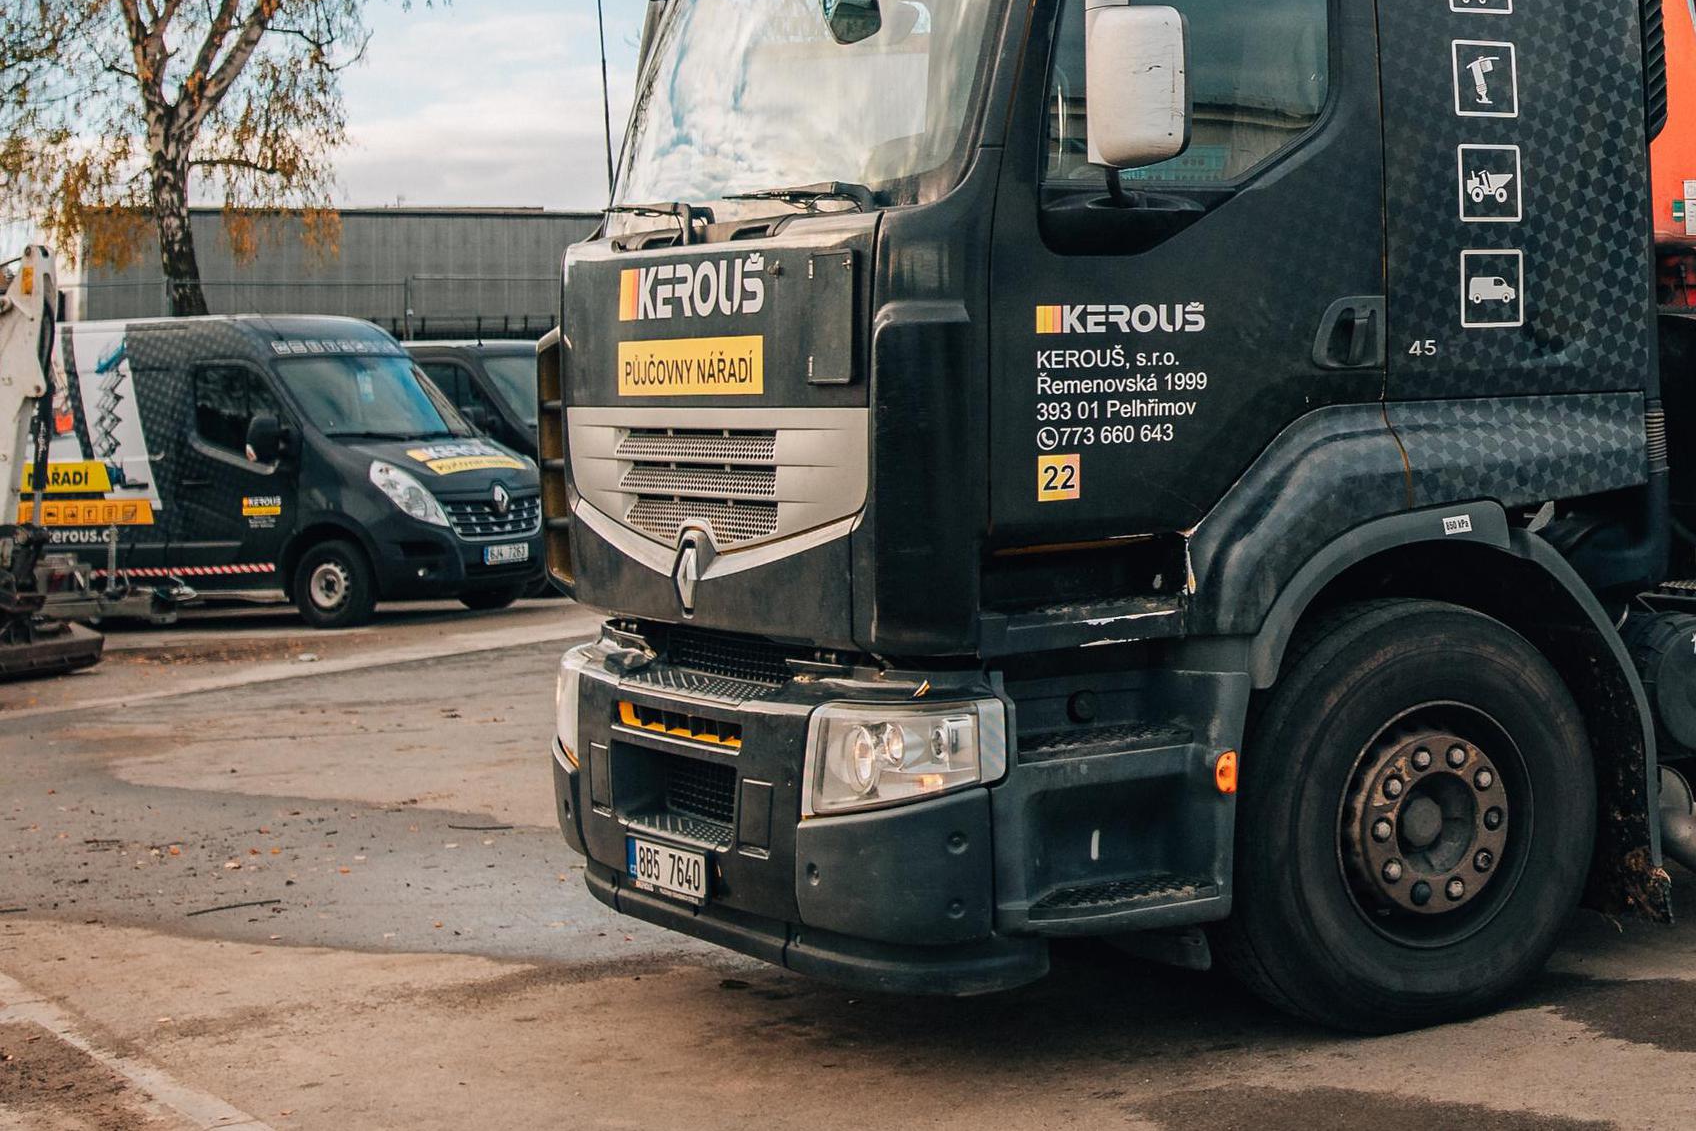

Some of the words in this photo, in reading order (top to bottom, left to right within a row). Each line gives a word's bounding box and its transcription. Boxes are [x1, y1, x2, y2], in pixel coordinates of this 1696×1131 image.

[638, 252, 765, 320] KEROUŠ
[1062, 301, 1206, 334] KEROUŠ
[1036, 345, 1130, 370] KEROUŠ,
[1136, 351, 1180, 367] s.r.o.
[1408, 339, 1437, 357] 45
[625, 354, 693, 386] PŮJČOVNY
[697, 350, 754, 384] NÁŘADÍ
[1036, 372, 1158, 395] Řemenovská
[1164, 372, 1208, 391] 1999
[1036, 402, 1072, 421] 393
[1077, 401, 1099, 419] 01
[1107, 398, 1197, 419] Pelhřimov
[1060, 426, 1095, 446] 773
[1100, 425, 1135, 444] 660
[1140, 423, 1174, 442] 643
[1042, 464, 1076, 491] 22
[638, 845, 660, 881] 8B5
[668, 853, 701, 891] 7640
